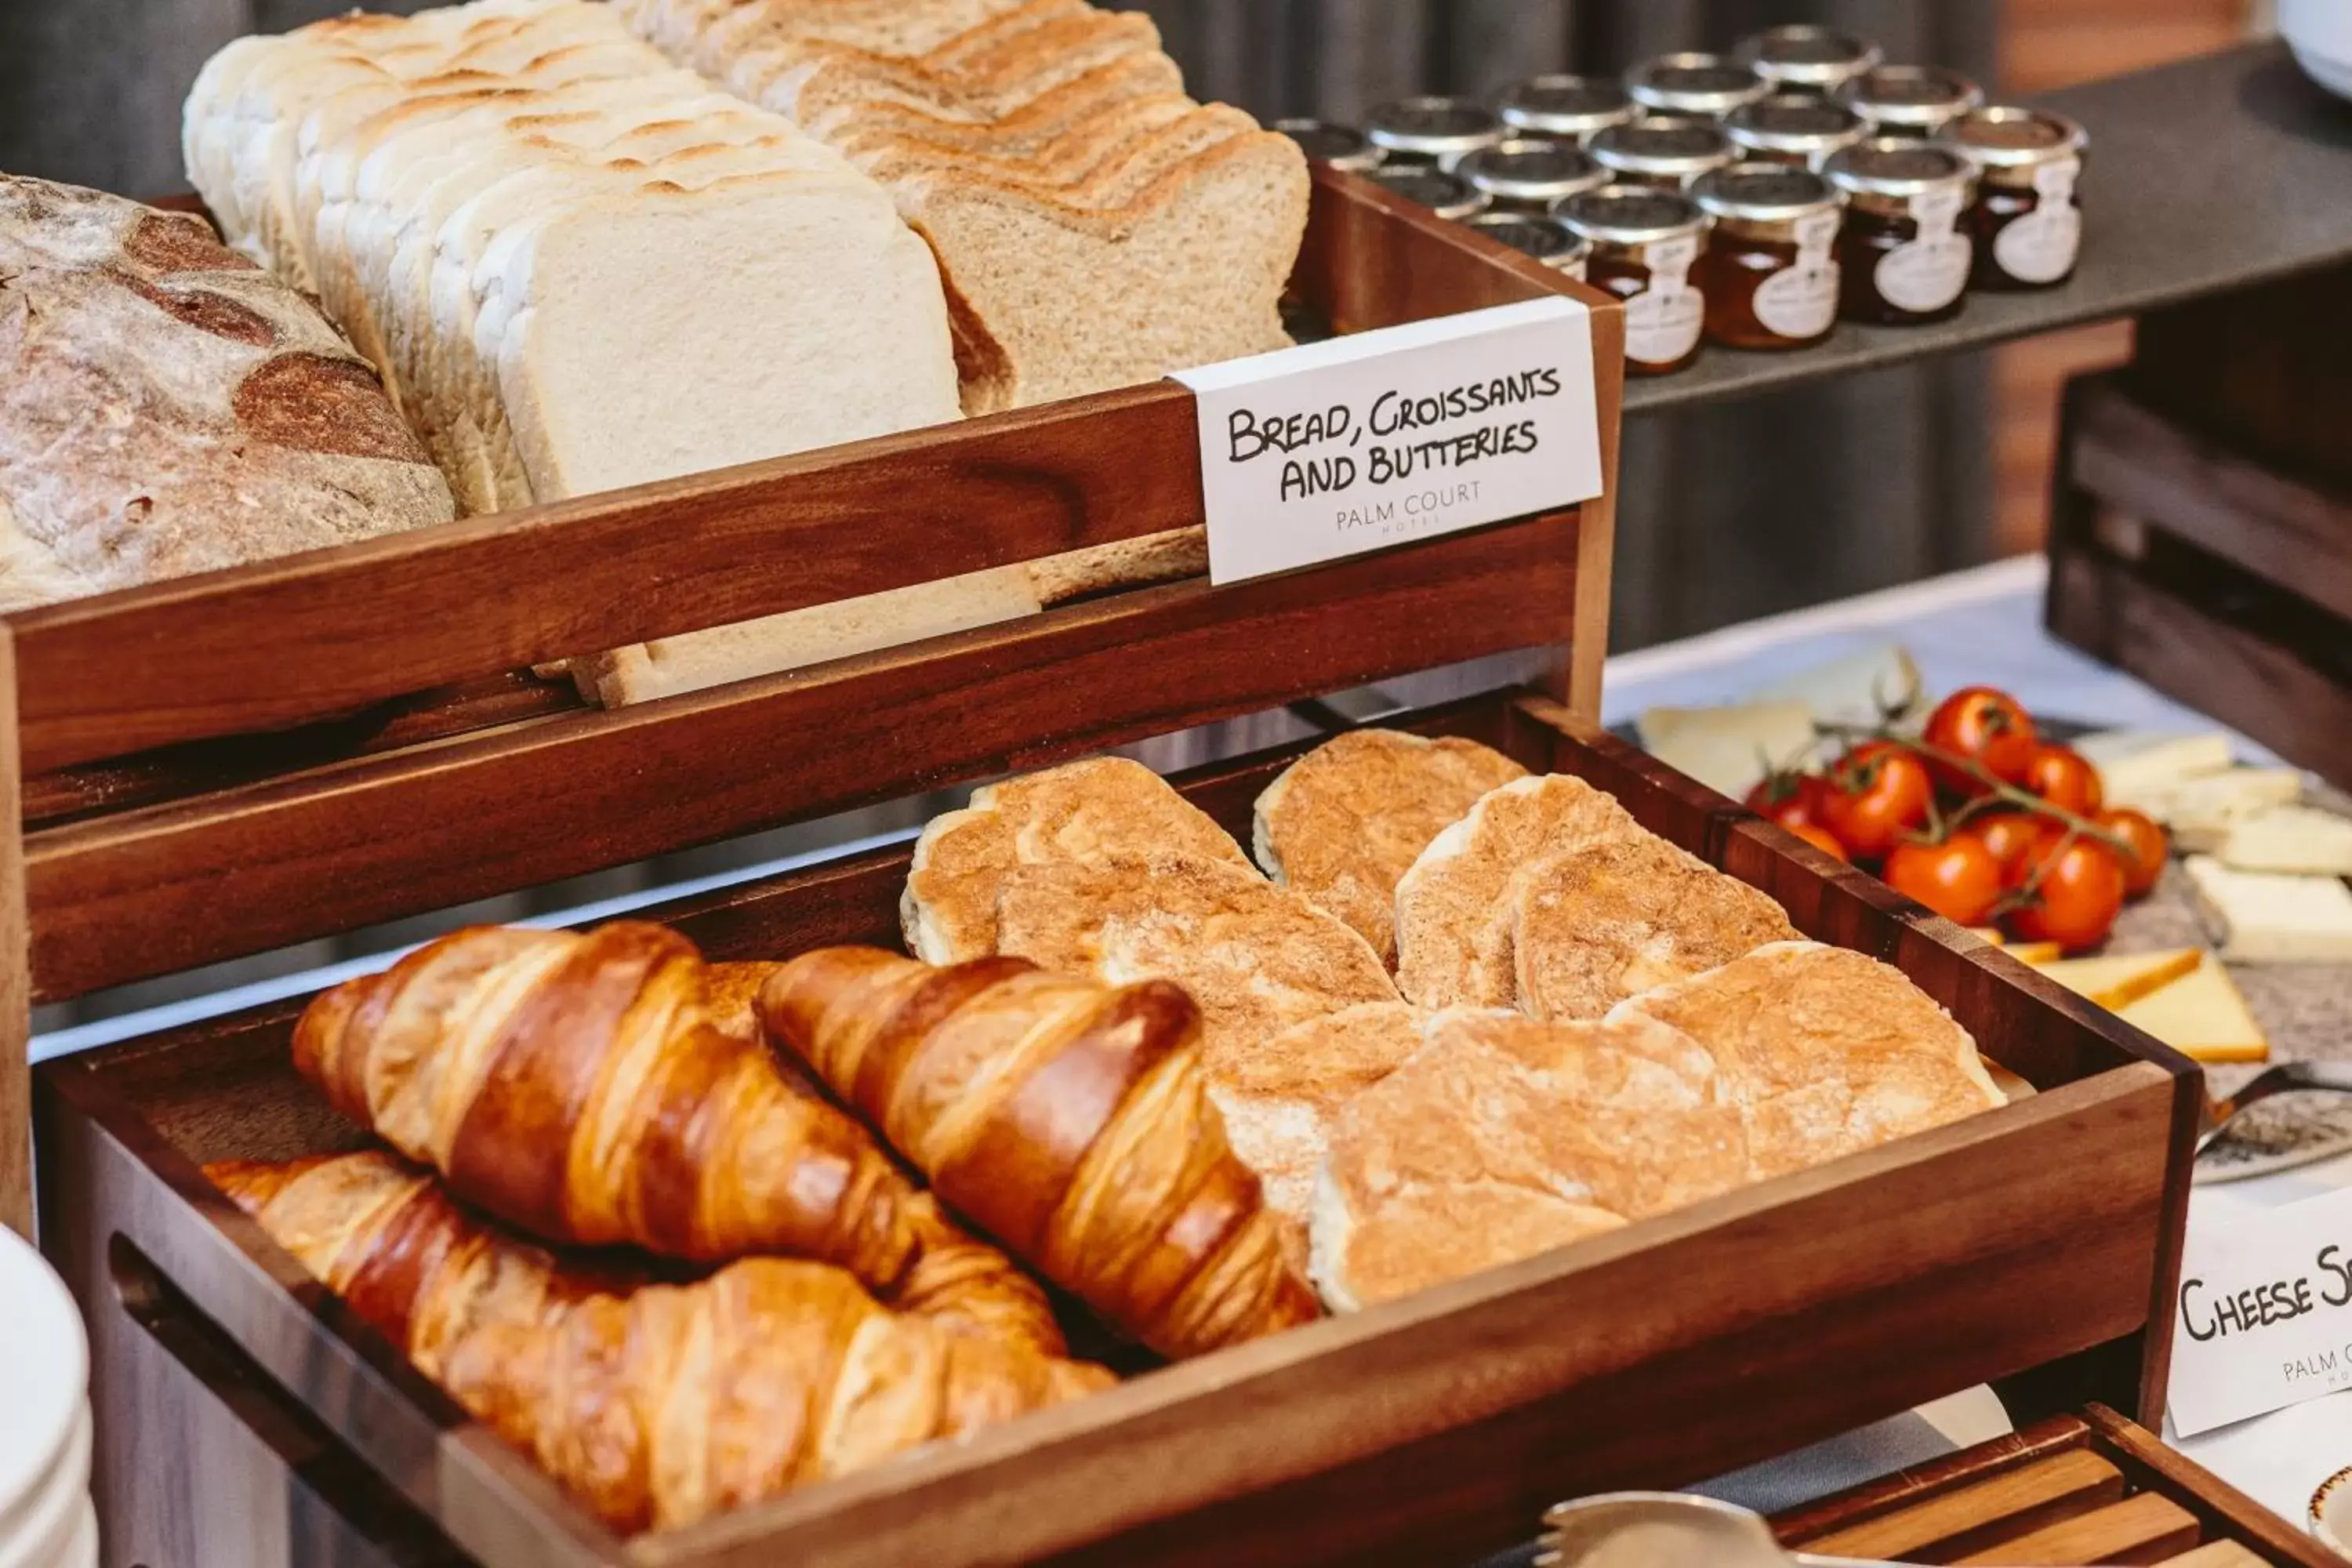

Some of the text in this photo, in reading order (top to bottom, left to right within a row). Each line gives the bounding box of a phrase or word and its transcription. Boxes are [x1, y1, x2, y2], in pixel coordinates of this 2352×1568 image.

[1369, 368, 1561, 437] CROISSANTS
[1280, 420, 1538, 502] AND BUTTERIES
[1337, 481, 1481, 531] PALM COURT
[2180, 1278, 2314, 1341] CHEESE
[2283, 1350, 2337, 1381] PALM
